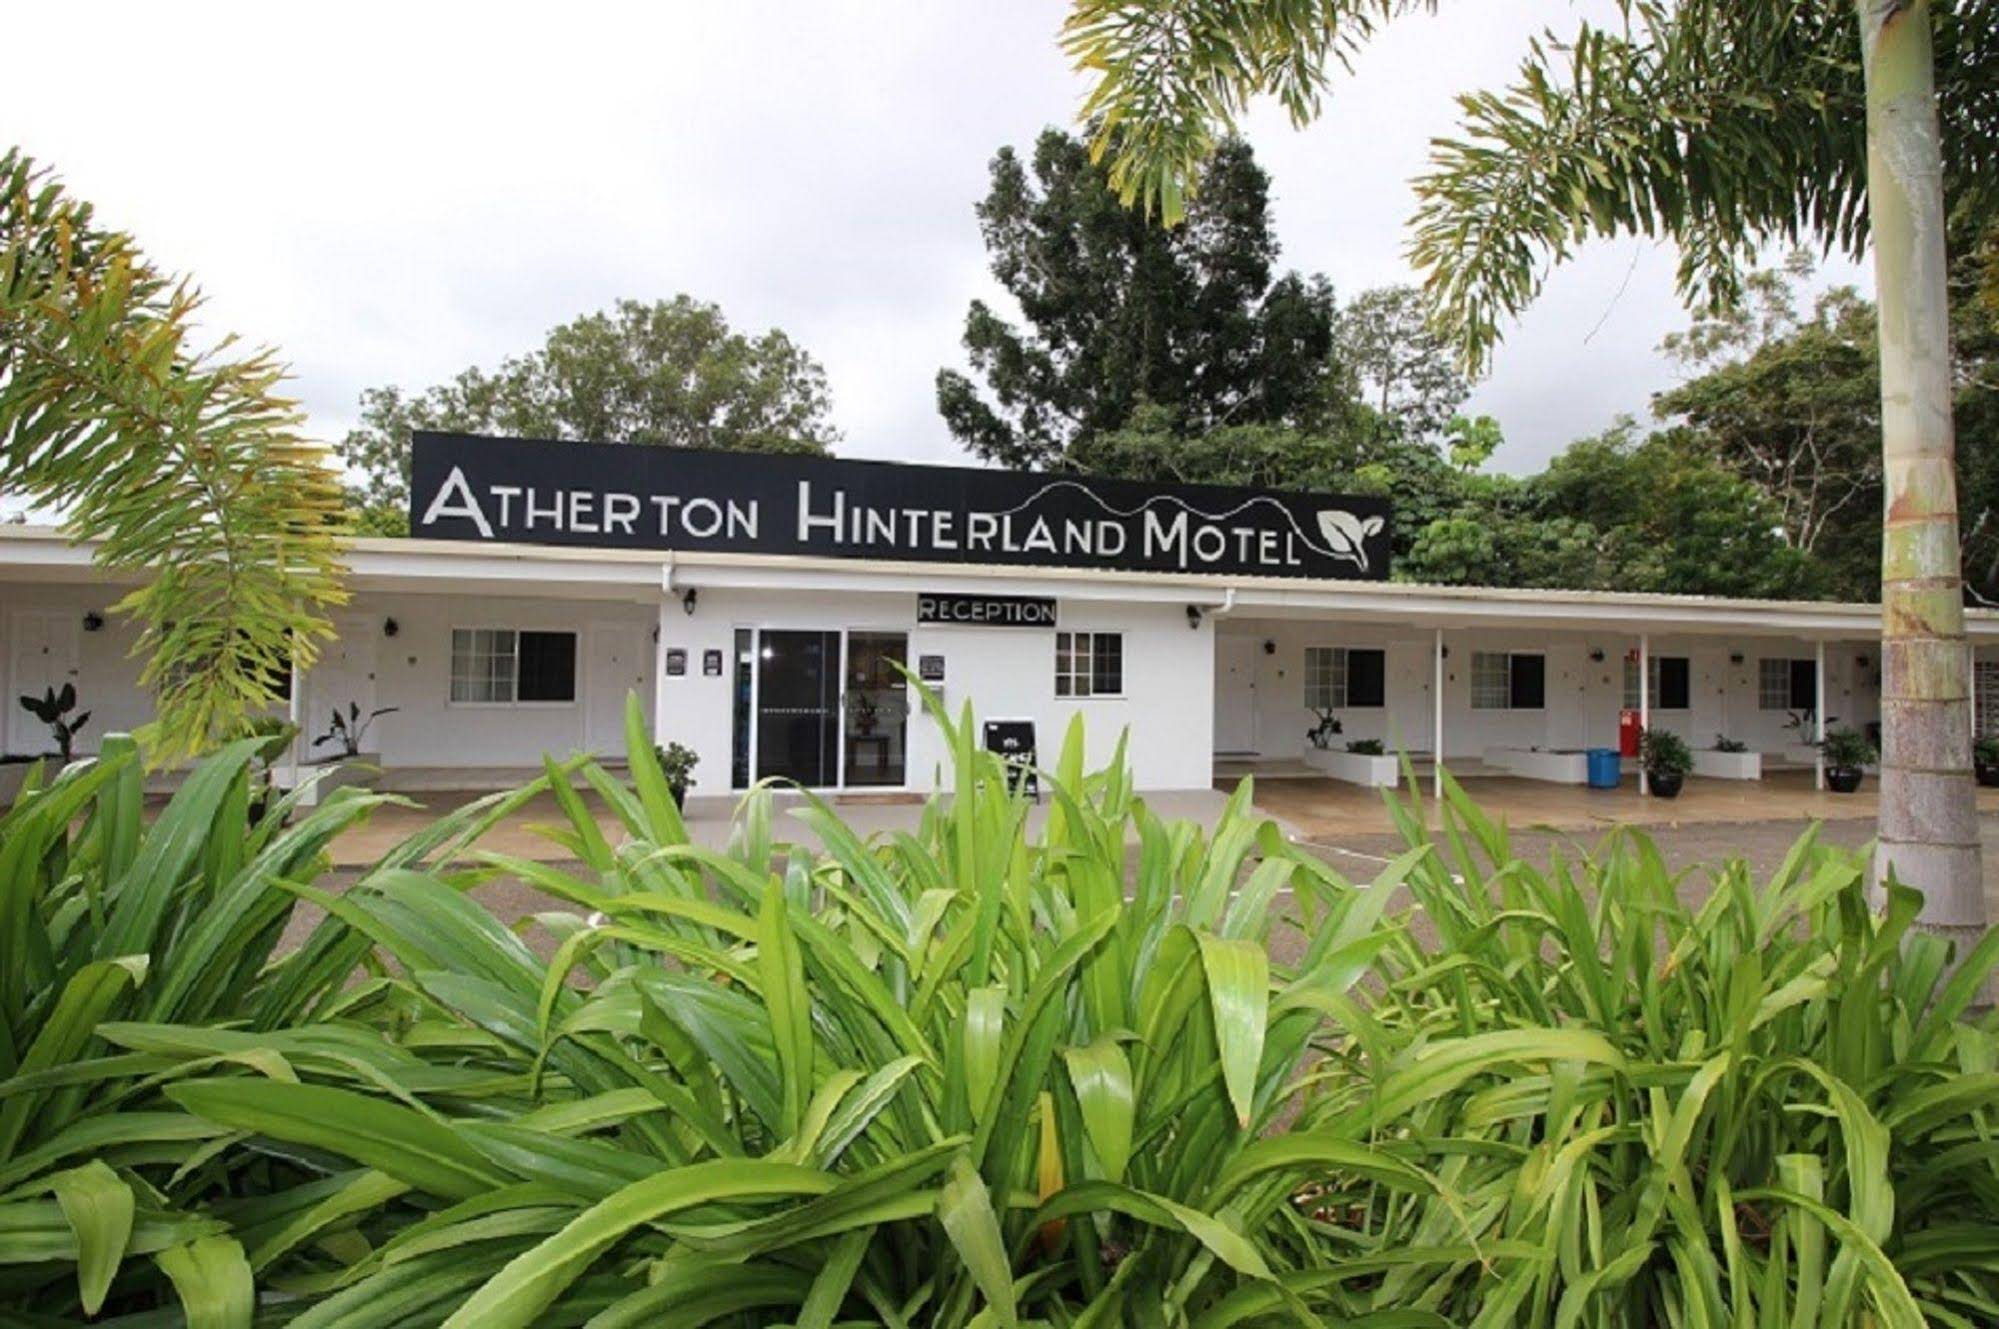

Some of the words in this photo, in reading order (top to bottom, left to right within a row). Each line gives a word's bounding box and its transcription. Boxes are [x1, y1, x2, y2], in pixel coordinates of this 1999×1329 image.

[422, 466, 758, 540] ATHERTON
[797, 481, 1126, 556] HINTERLAND
[1143, 509, 1302, 569] MOTEL
[918, 599, 1056, 622] RECEPTION
